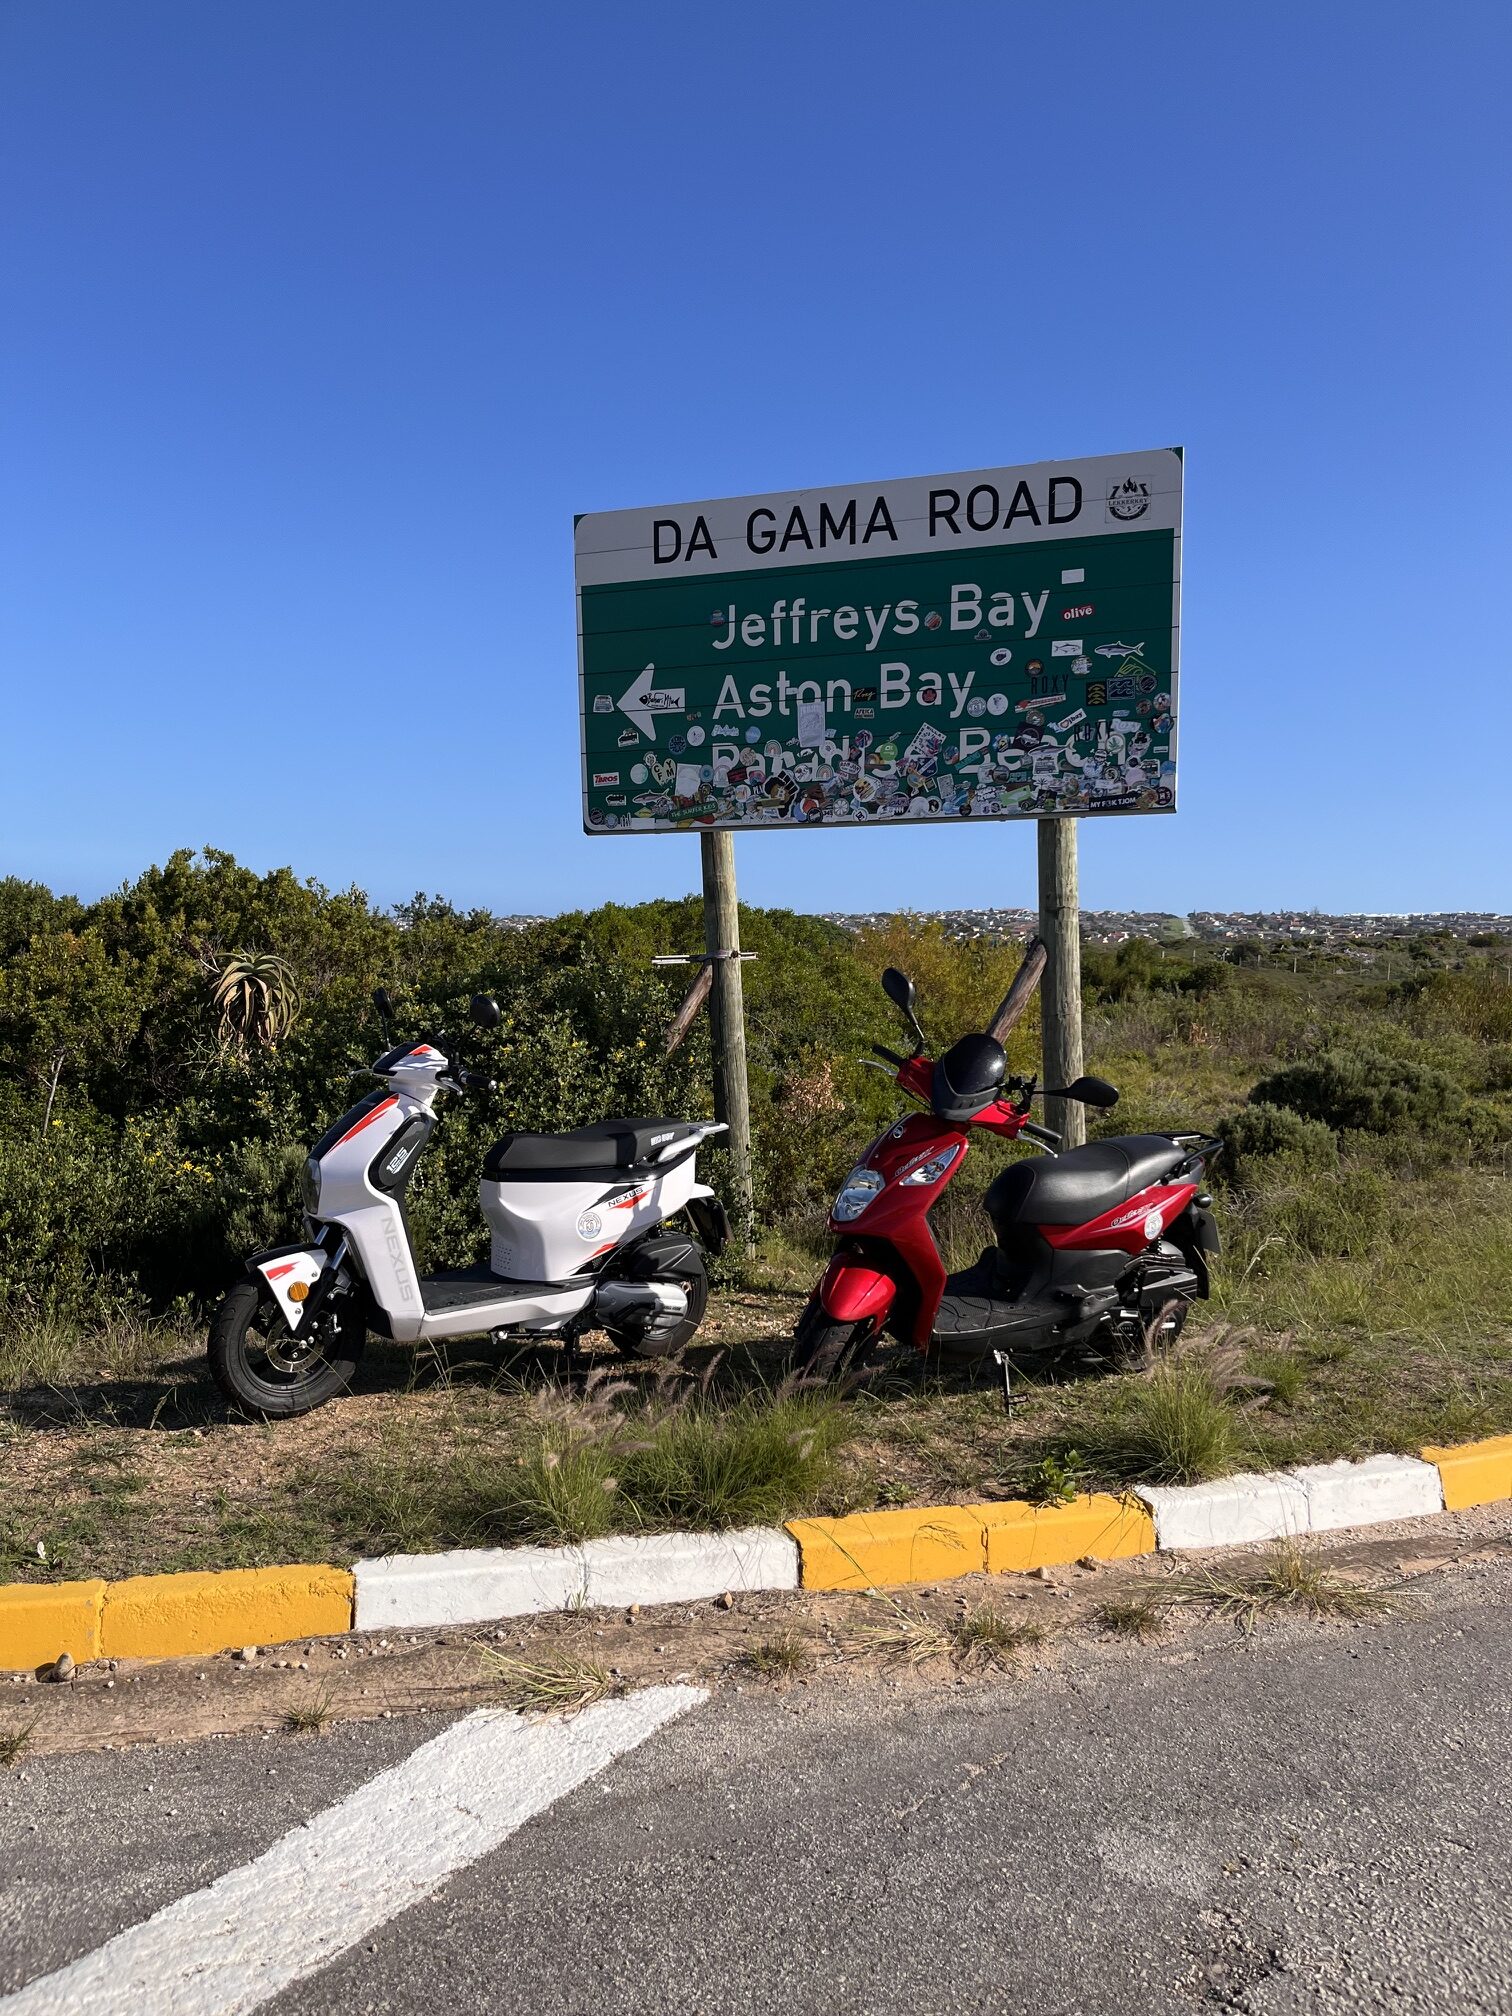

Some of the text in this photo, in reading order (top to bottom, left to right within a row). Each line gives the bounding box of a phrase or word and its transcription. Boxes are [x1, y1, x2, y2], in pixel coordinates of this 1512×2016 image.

[653, 476, 1082, 564] DA GAMA ROAD
[712, 583, 1050, 651] Jeffreys Bay
[1064, 606, 1093, 621] olive
[712, 662, 976, 720] Aston Bay
[1031, 673, 1069, 695] ROXY
[386, 1146, 409, 1175] 125
[608, 1187, 646, 1208] NEXUS
[381, 1216, 414, 1302] NEXUS
